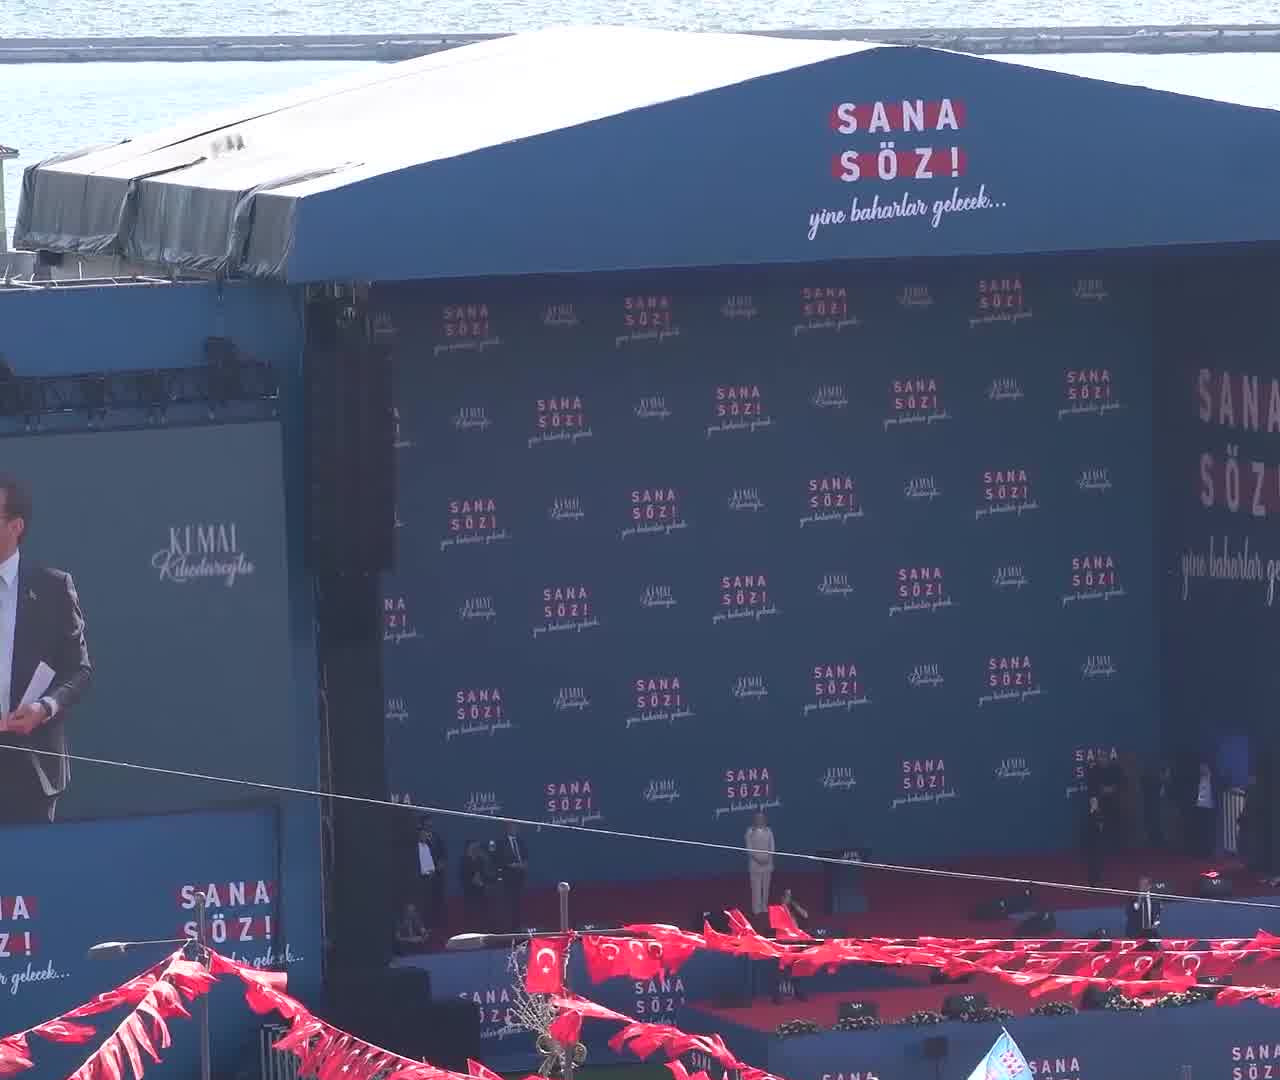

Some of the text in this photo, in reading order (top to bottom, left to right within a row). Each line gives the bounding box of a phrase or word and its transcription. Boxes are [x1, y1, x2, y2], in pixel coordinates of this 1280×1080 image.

[837, 98, 960, 135] SANA
[840, 141, 959, 182] SÖZ!
[807, 208, 846, 240] yine
[850, 191, 928, 223] baharlar
[1067, 370, 1110, 383] SANA
[717, 386, 760, 400] SANA
[894, 380, 937, 393] SANA
[809, 478, 853, 491] SANA
[984, 470, 1027, 484] SANA
[632, 489, 676, 502] SANA
[985, 485, 1028, 500] SÖZ!
[450, 500, 496, 513] SANA
[810, 493, 854, 508] SÖZ!
[633, 503, 677, 519] SÖZ!
[1072, 556, 1114, 570] SANA
[1209, 535, 1263, 581] baharlar
[722, 576, 766, 589] SANA
[899, 569, 941, 581] SANA
[544, 588, 588, 601] SANA
[899, 582, 943, 597] SÖZ!
[723, 590, 768, 605] SÖZ!
[544, 602, 588, 617] SÖZ!
[989, 656, 1031, 670] SANA
[814, 665, 857, 679] SANA
[989, 671, 1032, 686] SÖZ!
[636, 678, 680, 692] SANA
[815, 680, 858, 695] SÖZ!
[456, 690, 501, 703] SANA
[637, 693, 681, 709] SÖZ!
[903, 760, 945, 773] SANA
[726, 768, 770, 782] SANA
[547, 781, 591, 795] SANA
[727, 783, 771, 798] SÖZ!
[548, 797, 592, 812] SÖZ!
[181, 879, 271, 909] SANA
[183, 913, 272, 943] SÖZ!
[634, 978, 685, 994] SANA
[1029, 1057, 1080, 1073] SANA
